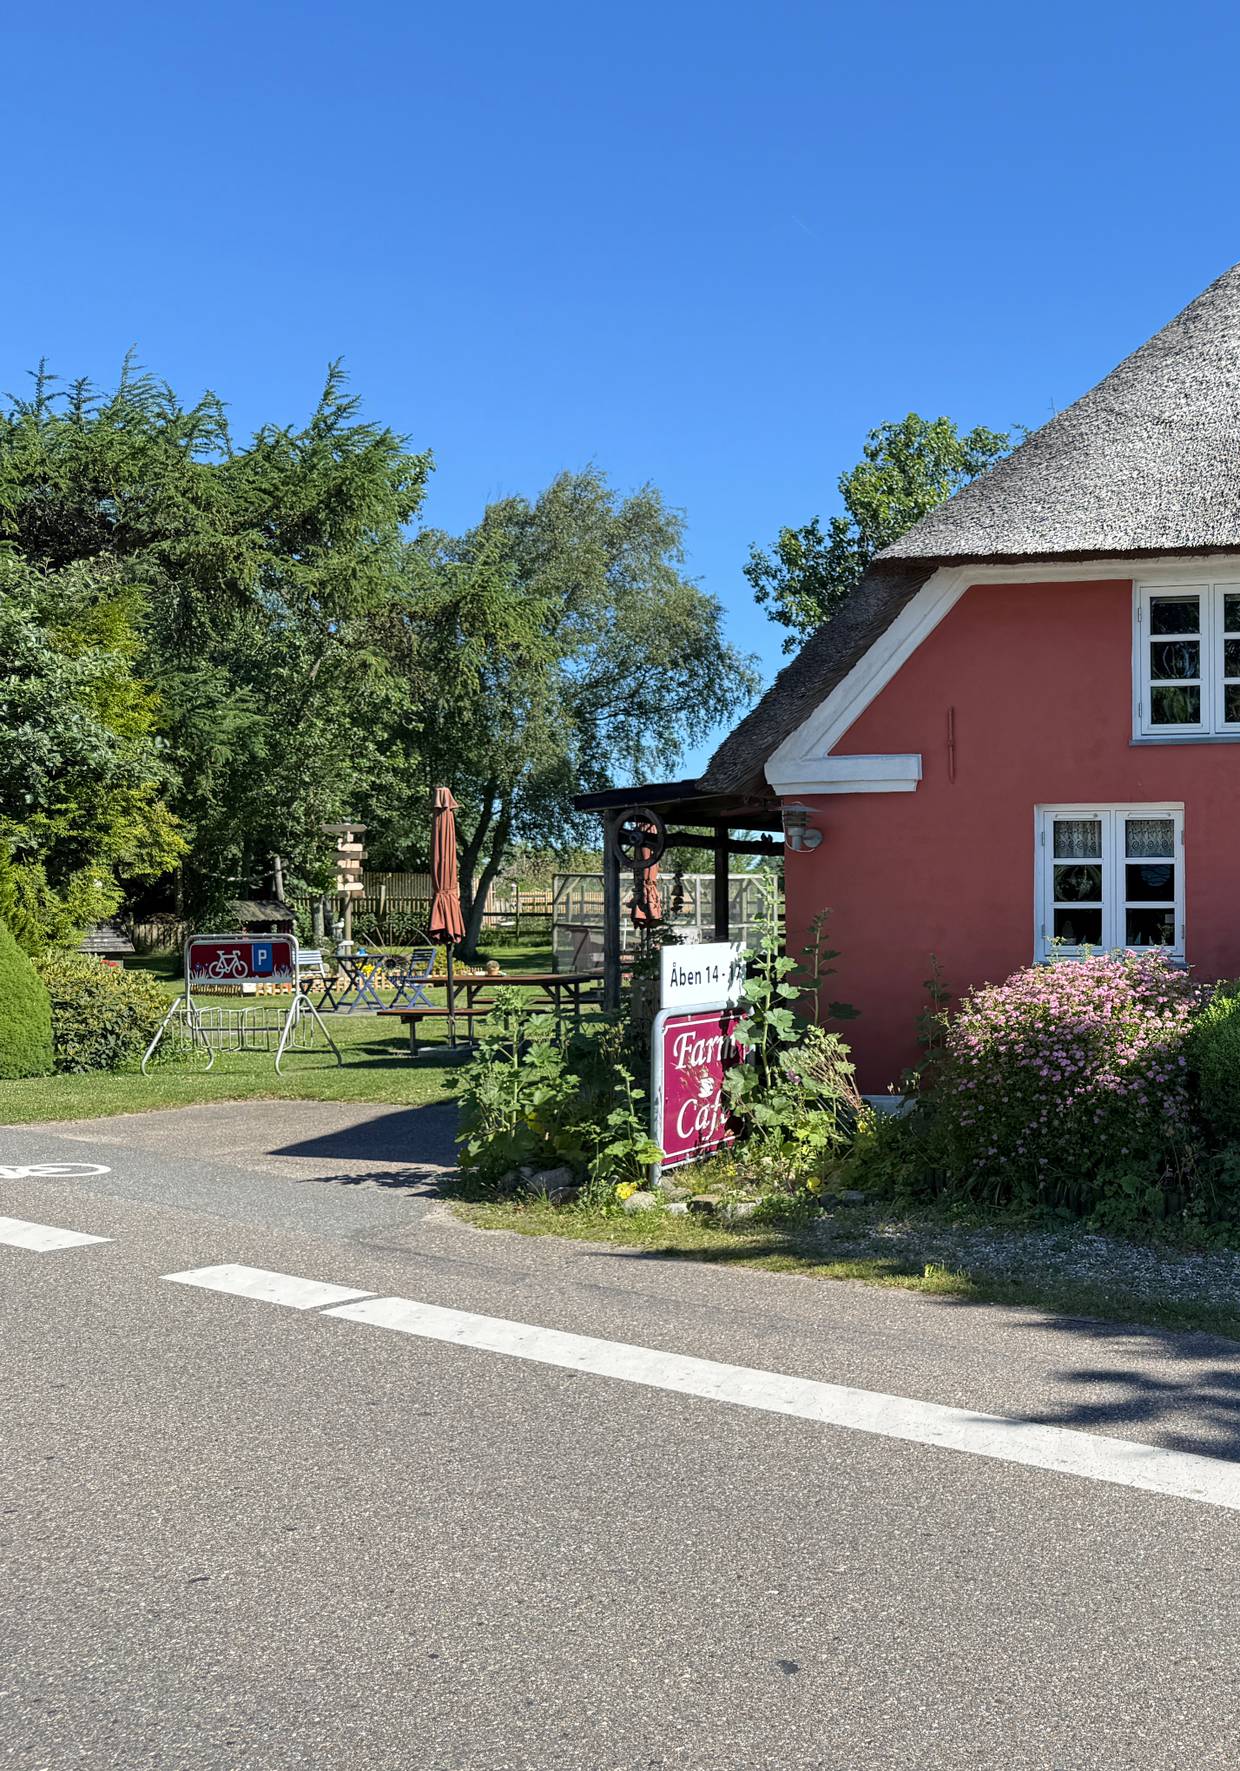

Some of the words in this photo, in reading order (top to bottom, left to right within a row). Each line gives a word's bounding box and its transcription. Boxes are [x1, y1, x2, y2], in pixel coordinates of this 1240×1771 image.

[258, 949, 267, 966] P
[670, 961, 702, 988] Åben
[705, 965, 719, 984] 14
